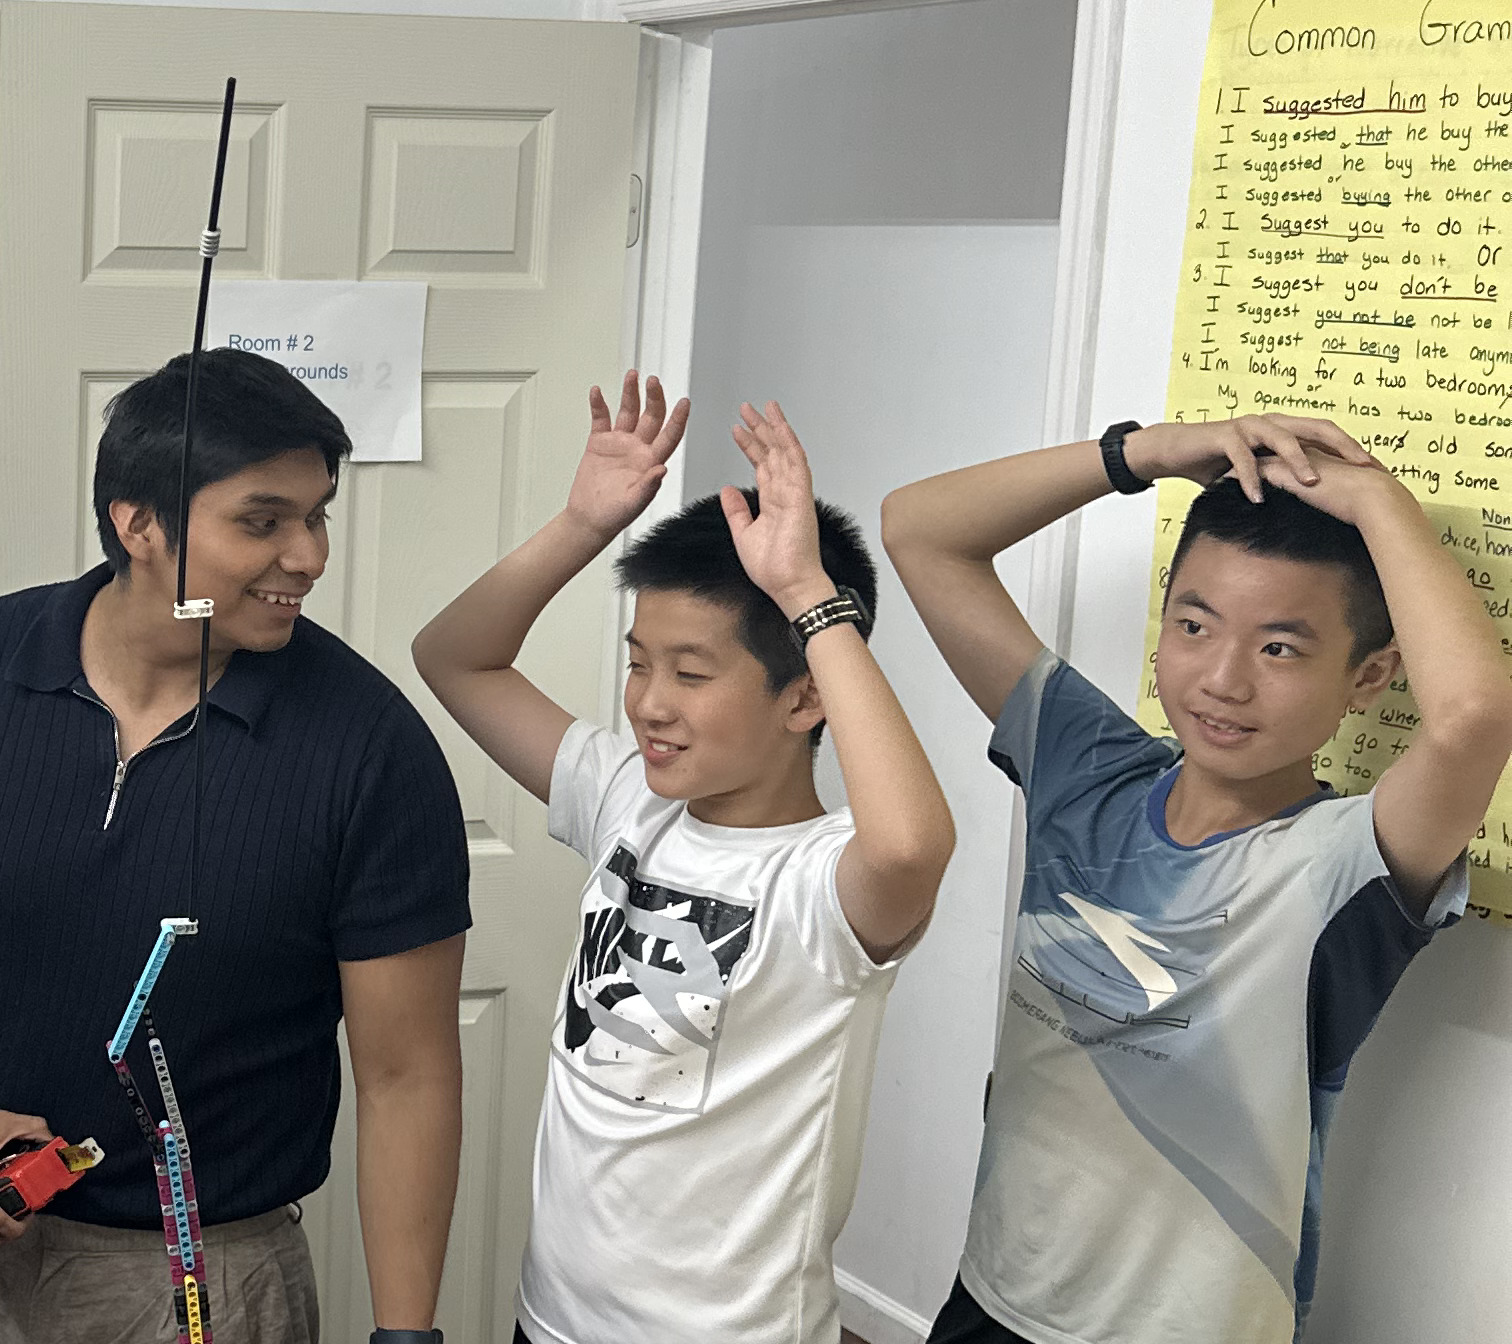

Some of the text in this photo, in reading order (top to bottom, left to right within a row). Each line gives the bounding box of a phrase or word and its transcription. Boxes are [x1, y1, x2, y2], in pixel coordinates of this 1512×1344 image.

[1262, 87, 1366, 120] suggested
[1389, 80, 1427, 111] him
[1439, 84, 1459, 109] to
[228, 333, 315, 353] Room # 2
[286, 362, 349, 380] rounds
[1353, 732, 1378, 755] go
